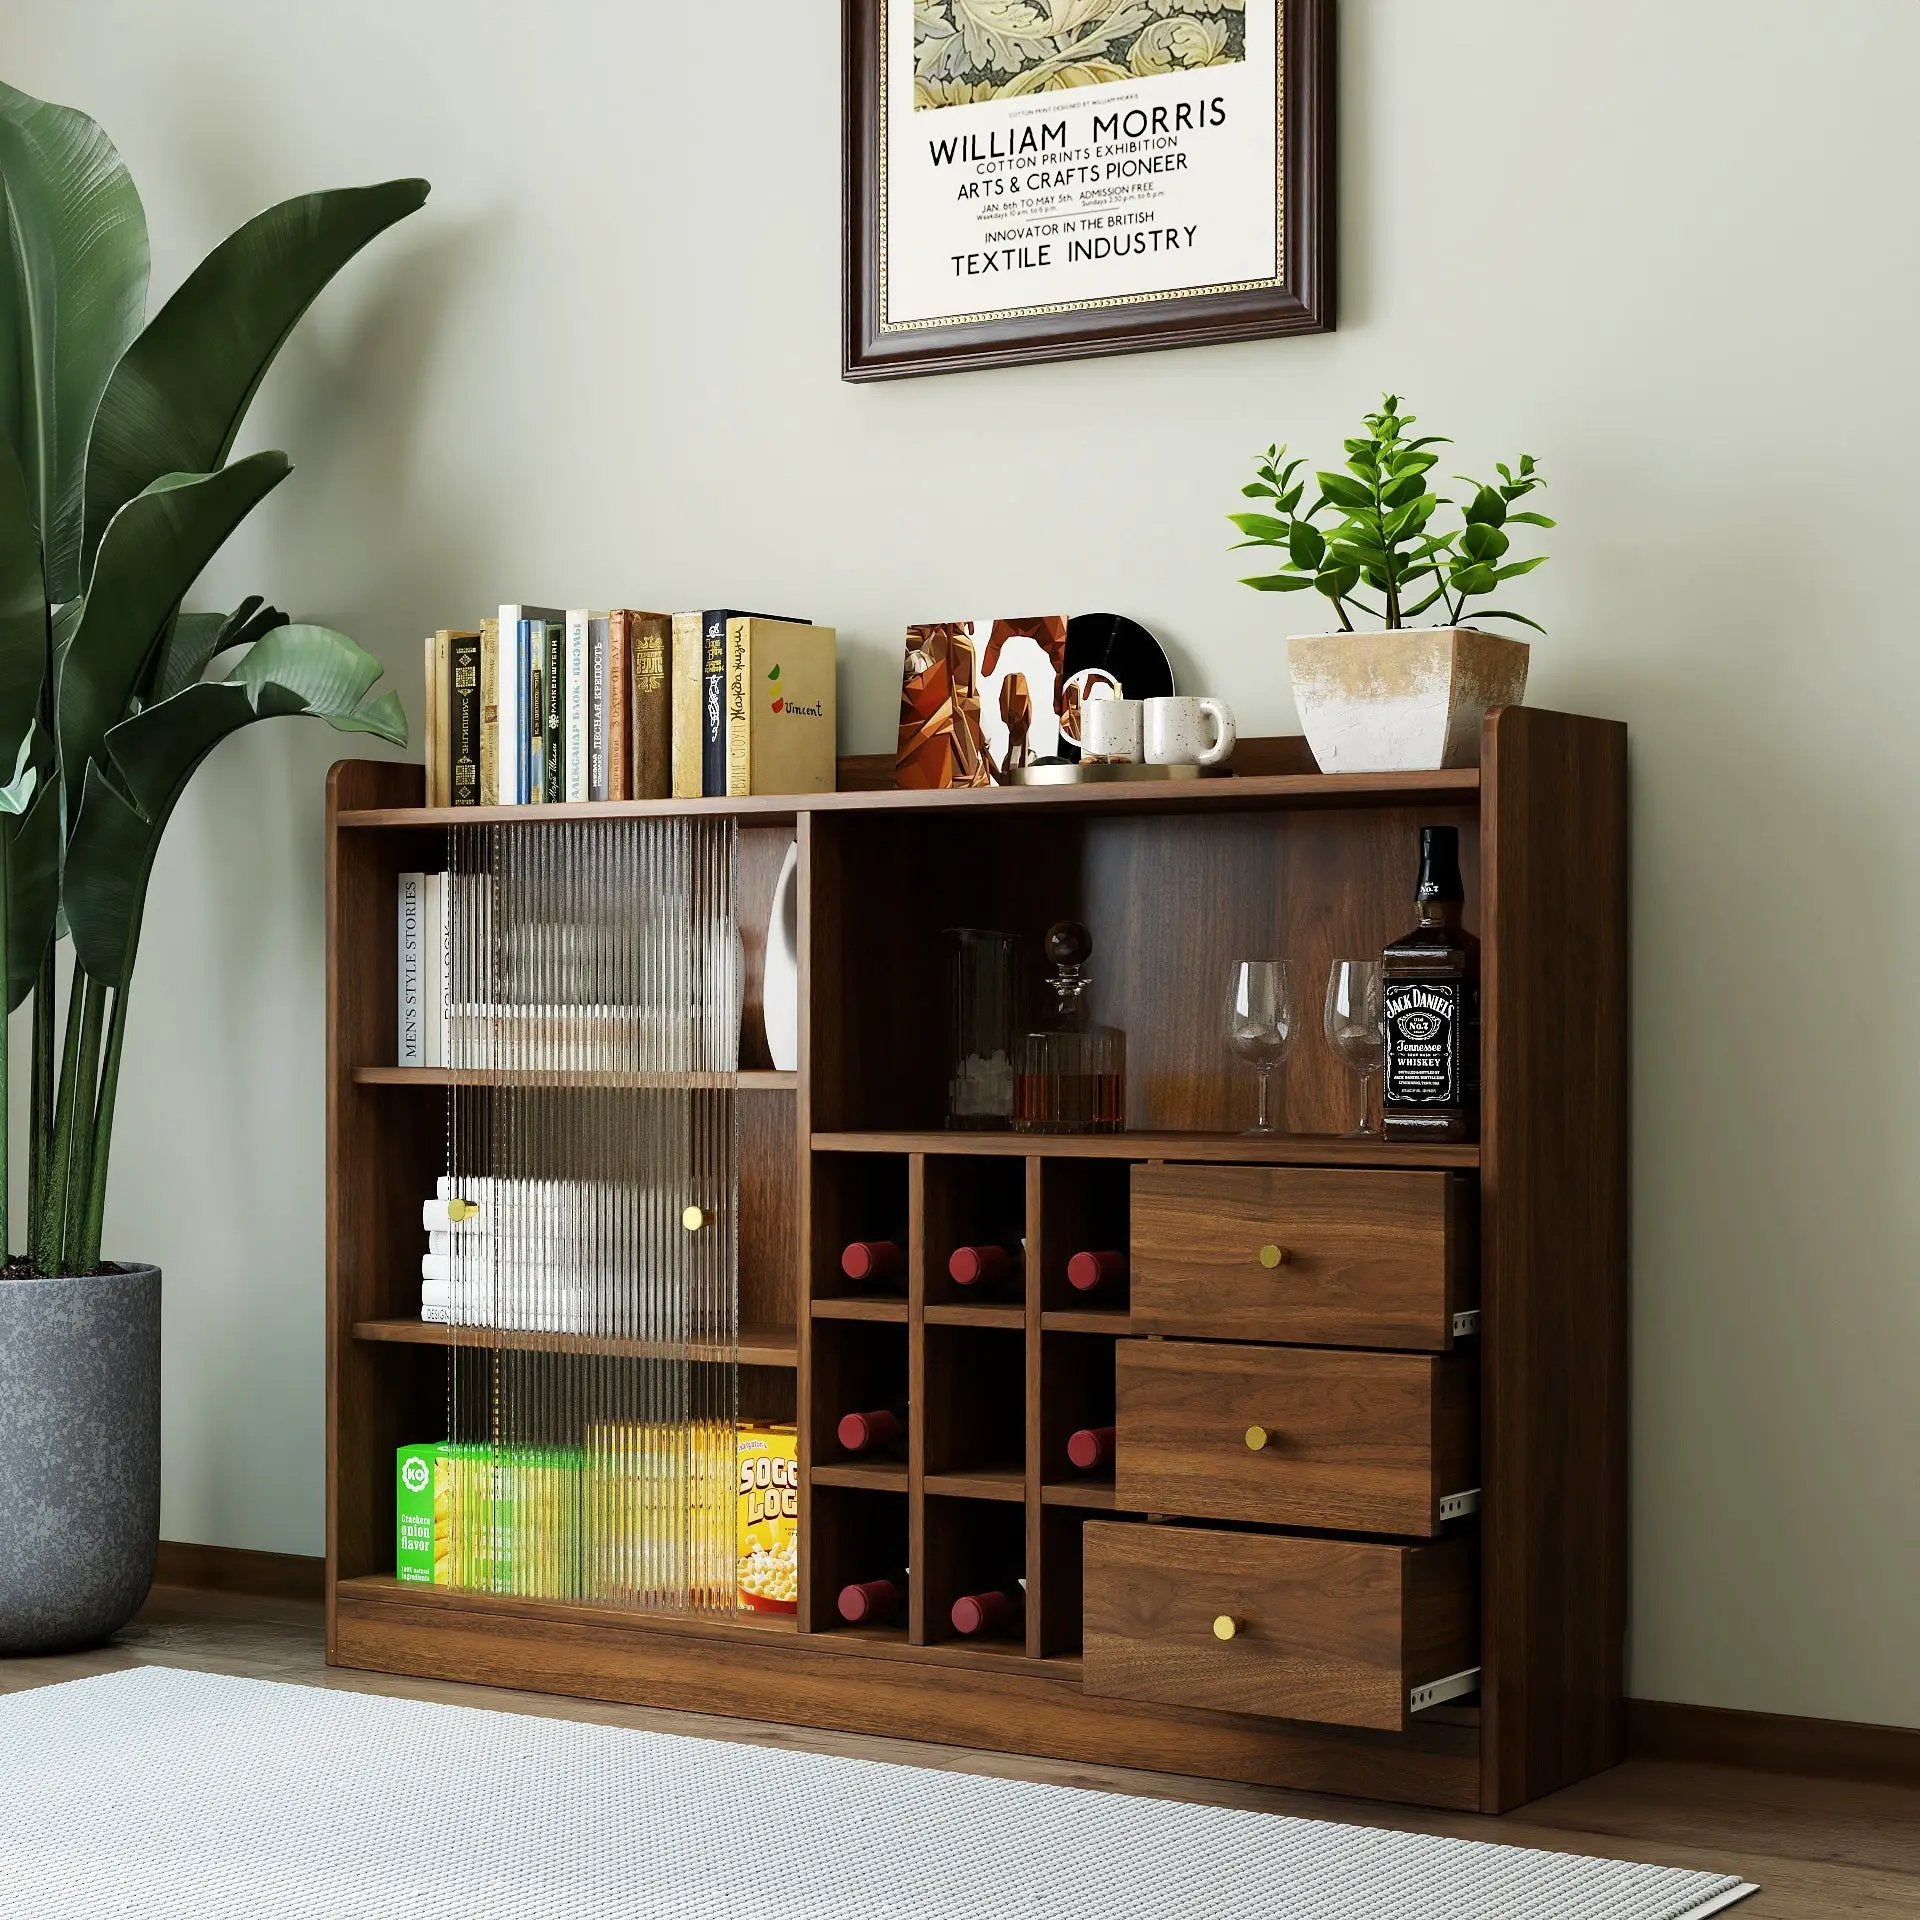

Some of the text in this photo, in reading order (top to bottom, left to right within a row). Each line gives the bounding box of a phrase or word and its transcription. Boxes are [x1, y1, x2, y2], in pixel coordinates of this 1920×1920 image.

[929, 96, 1226, 167] WILLIAM MORRIS
[976, 136, 1178, 175] COTTON PRINTS EXHIBITION
[957, 153, 1188, 201] ARTS & CRAFTS PIONEER
[1079, 181, 1154, 200] ADMISSION FREE
[1003, 201, 1018, 210] 6th
[1021, 198, 1034, 208] TO
[1036, 195, 1055, 206] MAY
[984, 211, 1155, 243] INNOVATOR IN THE BRITISH
[951, 225, 1198, 277] TEXTILE INDUSTRY
[730, 625, 746, 722] Жажда жизни
[571, 623, 582, 799] АЛЕКСАНДР БЛОК ПОЭМЫ
[593, 642, 603, 750] ЛЕСНАЯ КРЕПОСТЬ
[784, 700, 823, 717] Vincent
[730, 724, 746, 759] СТОУН
[405, 880, 417, 1059] MEN'S STYLE STORIES
[1386, 988, 1455, 1021] JACK DANIEL'S
[1409, 1022, 1429, 1031] No.7
[1396, 1039, 1442, 1052] Tennessee
[1397, 1058, 1441, 1067] WHISKEY
[406, 1468, 425, 1481] KO
[401, 1523, 430, 1539] onion
[401, 1535, 430, 1551] flavor
